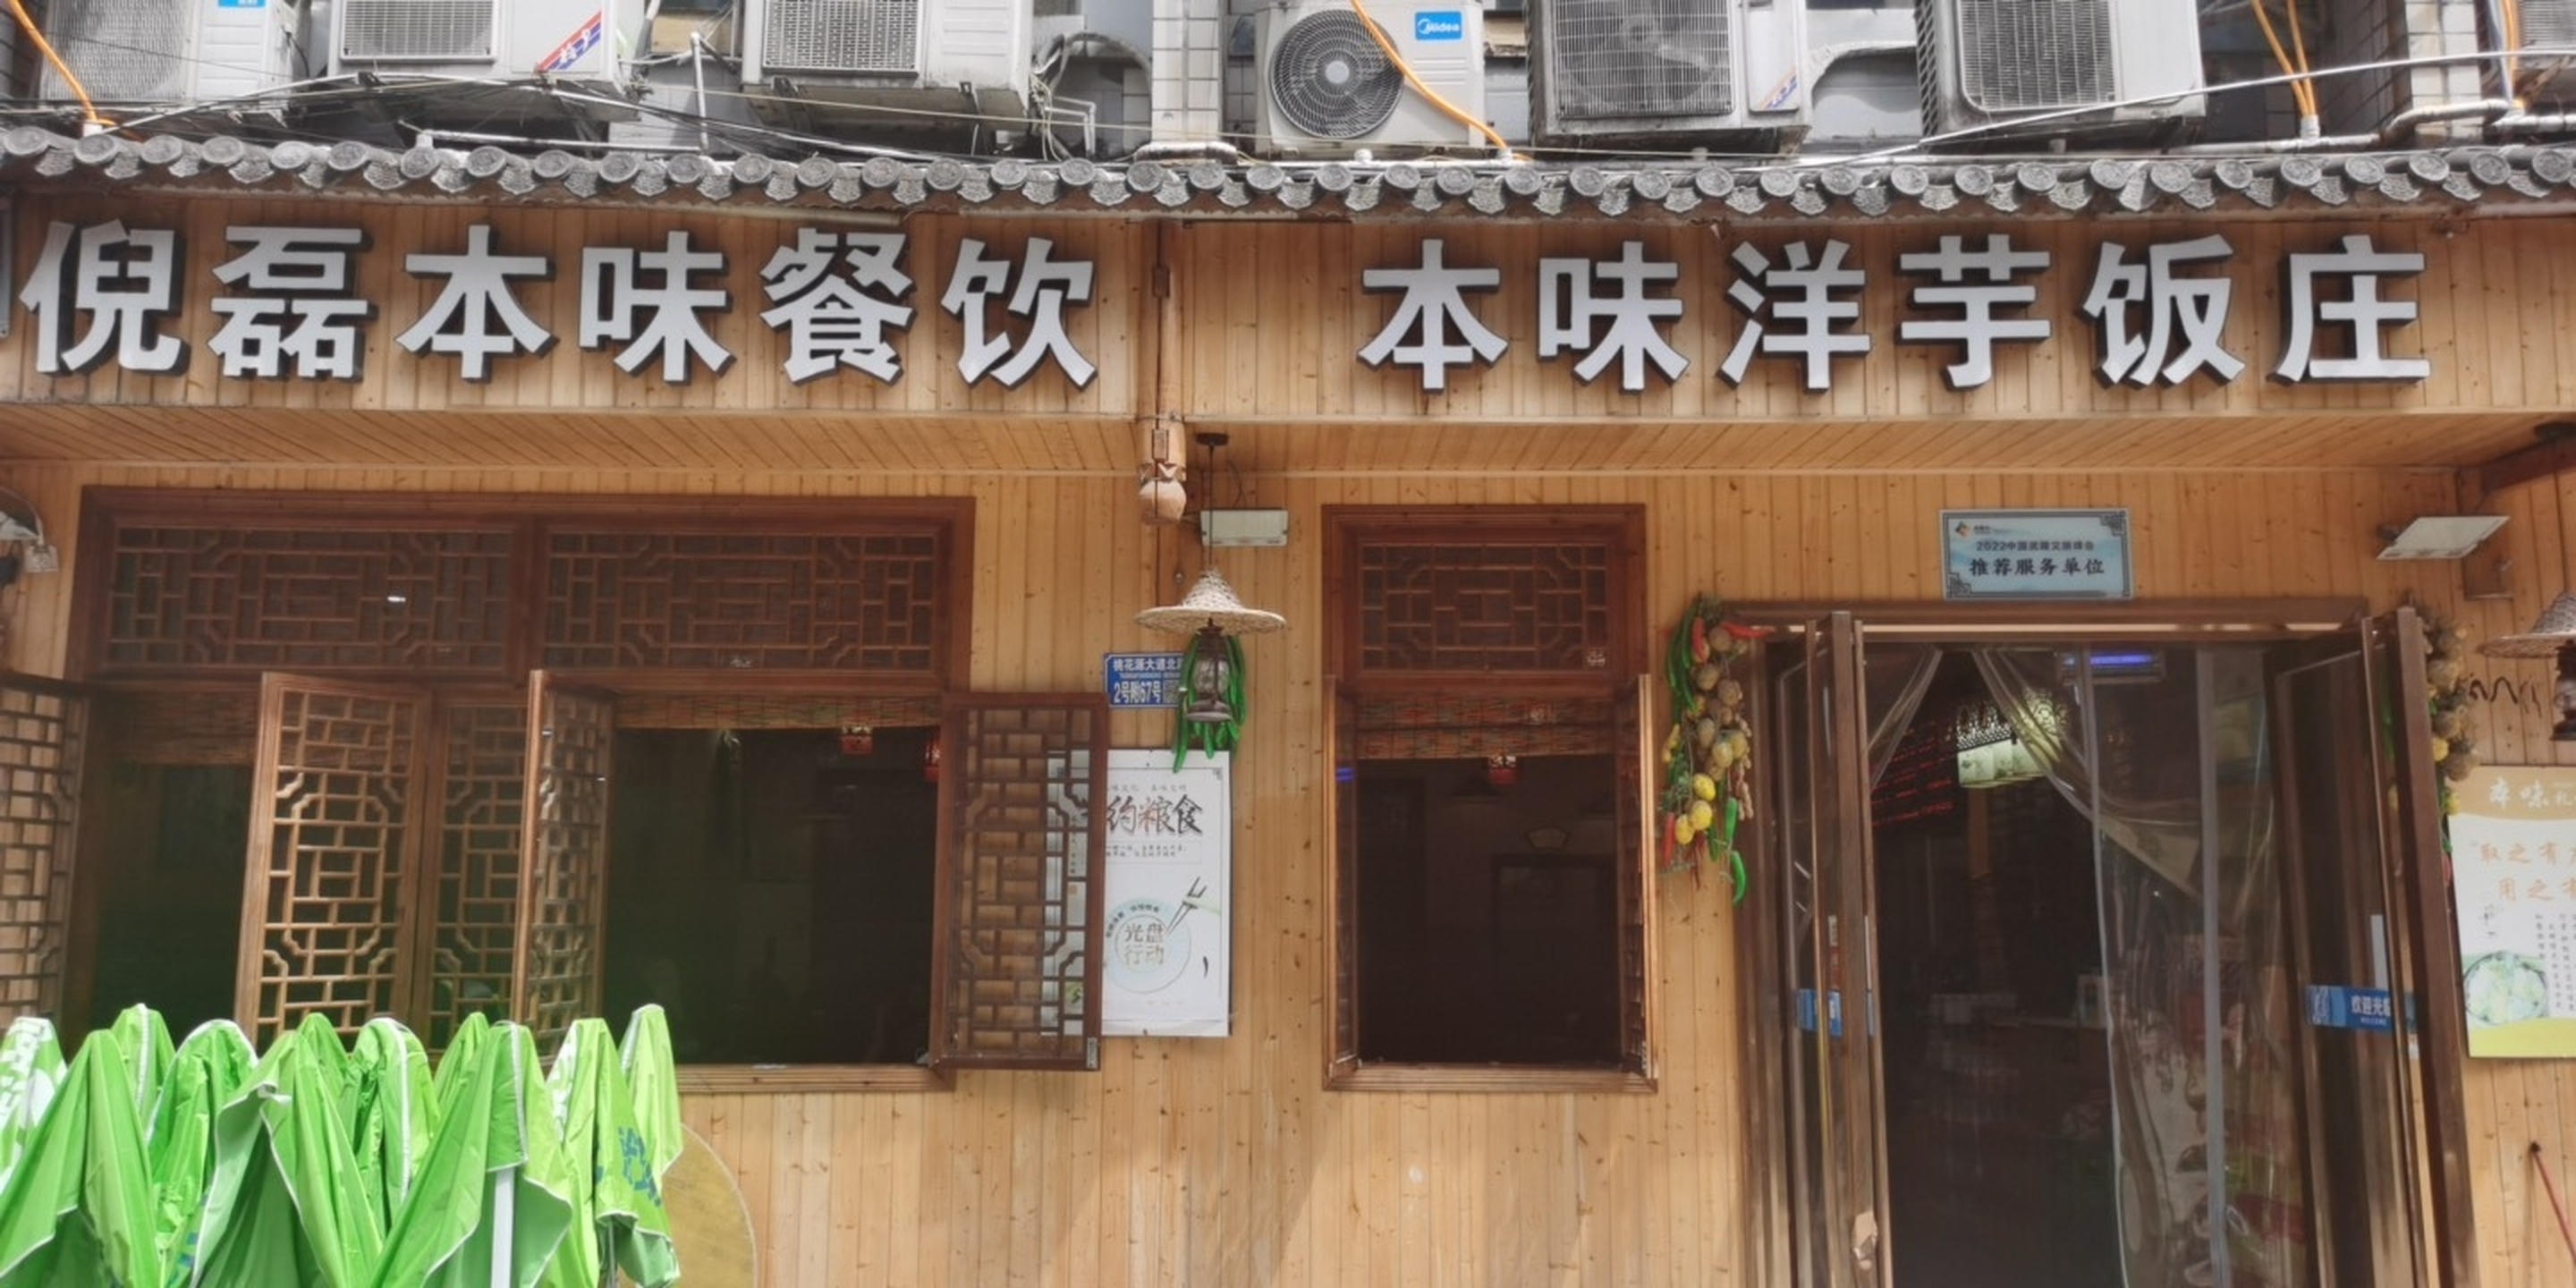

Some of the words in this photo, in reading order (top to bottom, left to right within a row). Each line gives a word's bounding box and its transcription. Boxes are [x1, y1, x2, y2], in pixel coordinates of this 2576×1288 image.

[20, 220, 1098, 388] 倪磊本味餐饮
[1358, 233, 2431, 394] 本味洋芋饭庄
[1970, 557, 2105, 576] 推荐服务单位
[1124, 923, 1163, 944] 光盘
[1123, 945, 1165, 966] 行动
